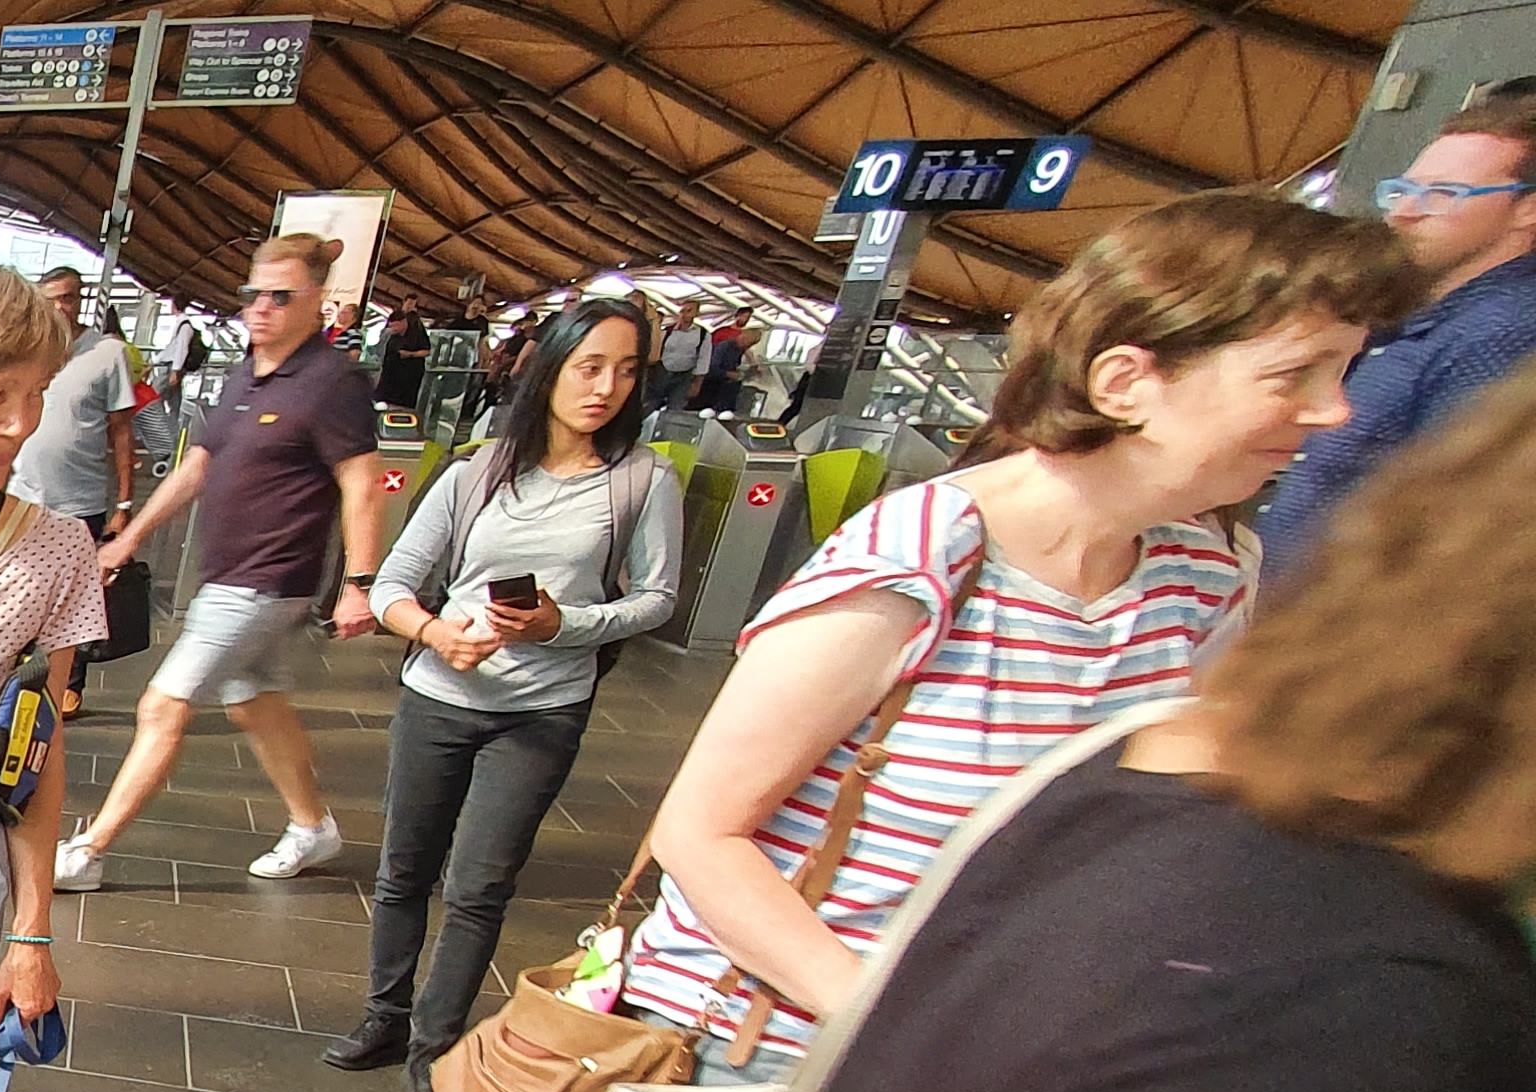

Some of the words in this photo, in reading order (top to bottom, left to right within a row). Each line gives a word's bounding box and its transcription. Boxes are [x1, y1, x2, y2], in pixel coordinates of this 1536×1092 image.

[850, 152, 905, 197] 10
[1028, 149, 1073, 194] 9
[867, 211, 899, 245] 10
